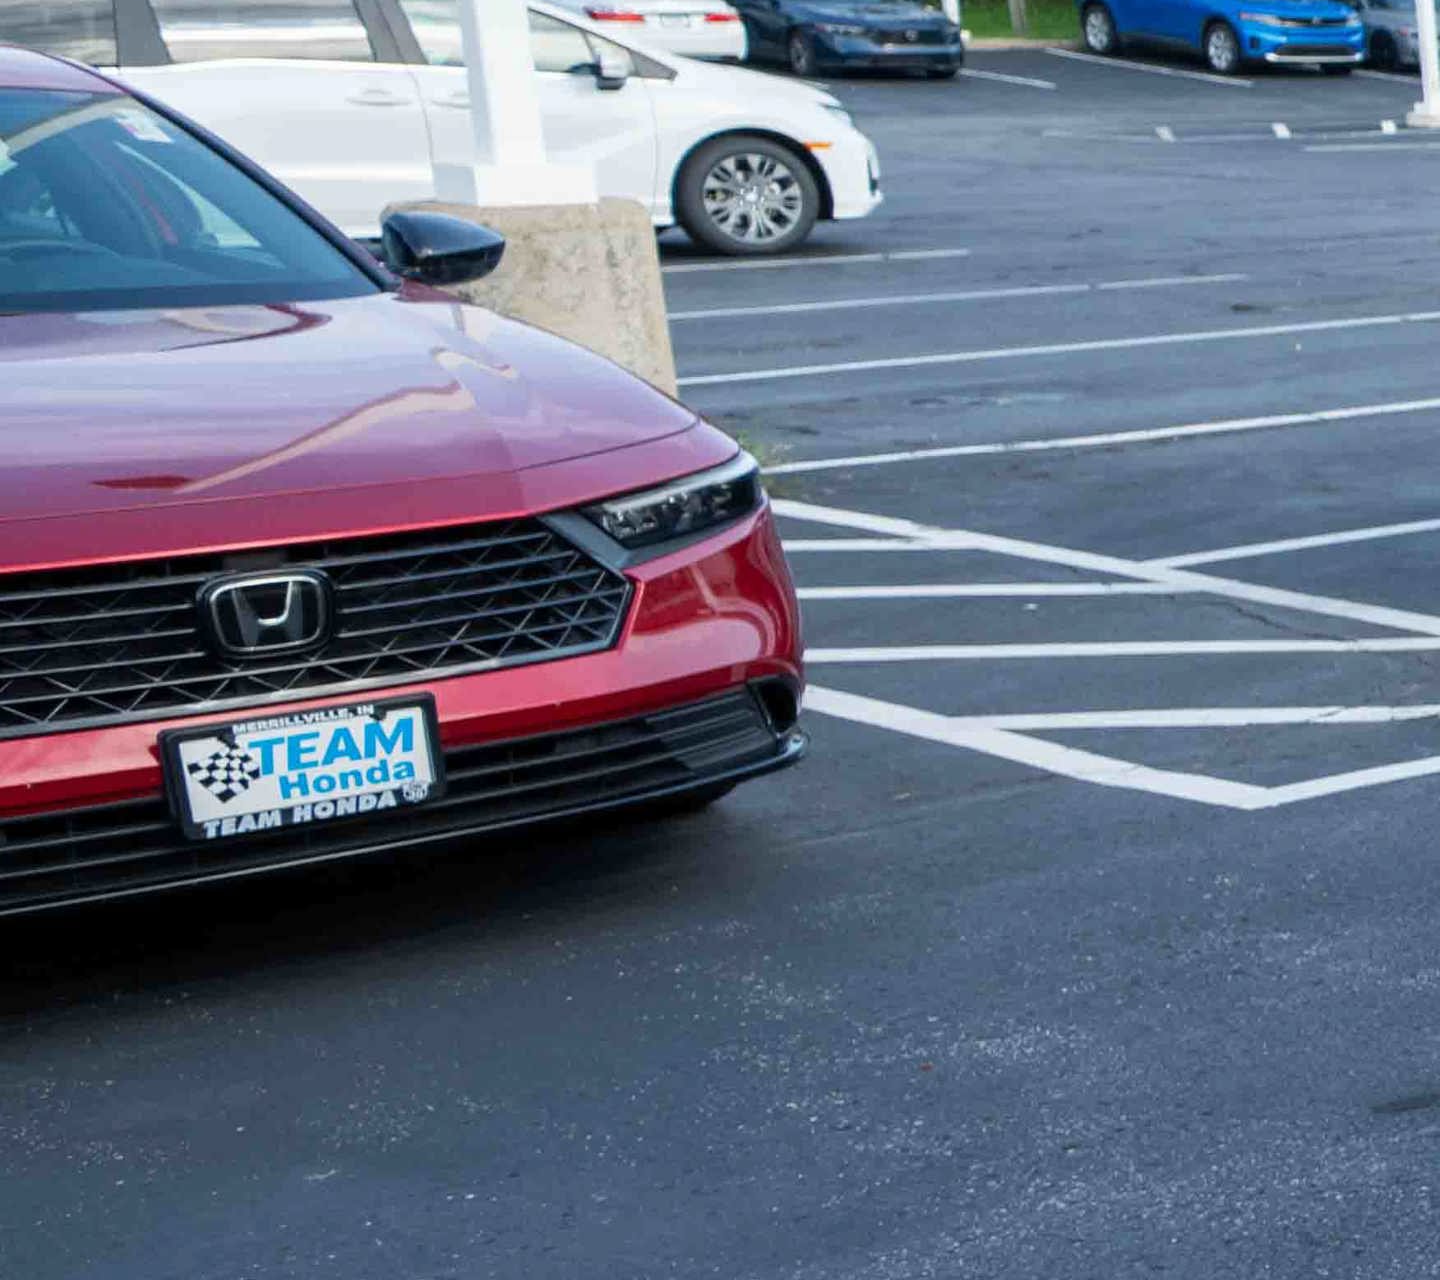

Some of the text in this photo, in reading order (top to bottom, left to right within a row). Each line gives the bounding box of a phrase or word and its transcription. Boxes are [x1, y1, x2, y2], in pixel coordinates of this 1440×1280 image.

[232, 703, 375, 735] MERRILLVILLE, IN
[248, 717, 415, 777] TEAM
[279, 759, 416, 800] Honda
[202, 811, 283, 840] TEAM
[292, 790, 398, 824] HONDA
